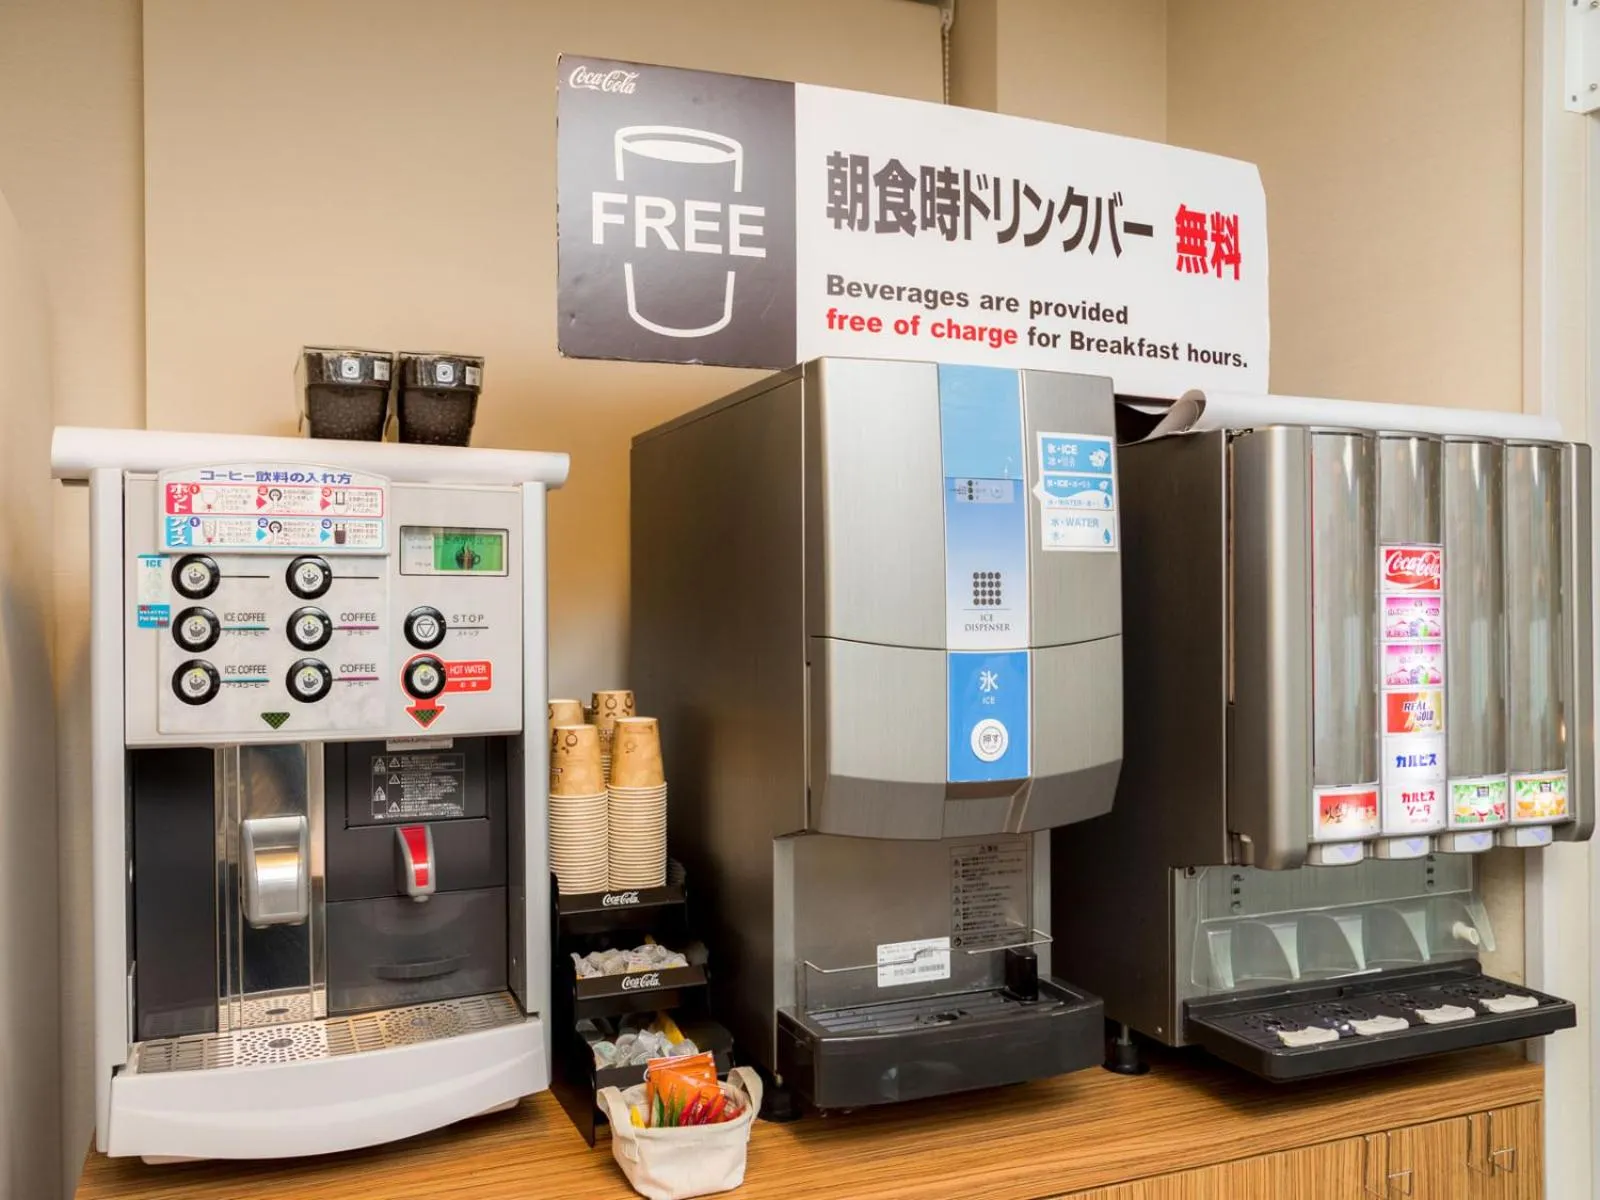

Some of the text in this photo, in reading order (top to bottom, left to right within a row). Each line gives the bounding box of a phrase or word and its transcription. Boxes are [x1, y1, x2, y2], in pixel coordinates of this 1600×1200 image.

[826, 150, 1242, 281] 朝食時ドリンクバー 無料
[591, 191, 766, 258] FREE
[826, 274, 1129, 326] Beverages are provided
[826, 308, 1249, 368] free of charge for Breakfast hours.
[200, 470, 352, 485] コーヒー飲料の入れ方
[145, 559, 162, 568] ICE
[223, 612, 265, 622] ICE COFFEE
[340, 612, 377, 622] COFFEE
[452, 614, 485, 623] STOP
[979, 614, 993, 623] ICE
[964, 623, 1011, 632] DISPENSER
[224, 664, 267, 674] ICE COFFEE
[339, 663, 377, 673] COFFEE
[449, 664, 487, 674] HOT WATER
[979, 670, 999, 693] 氷
[982, 696, 996, 705] ICE
[1404, 700, 1426, 711] REAL
